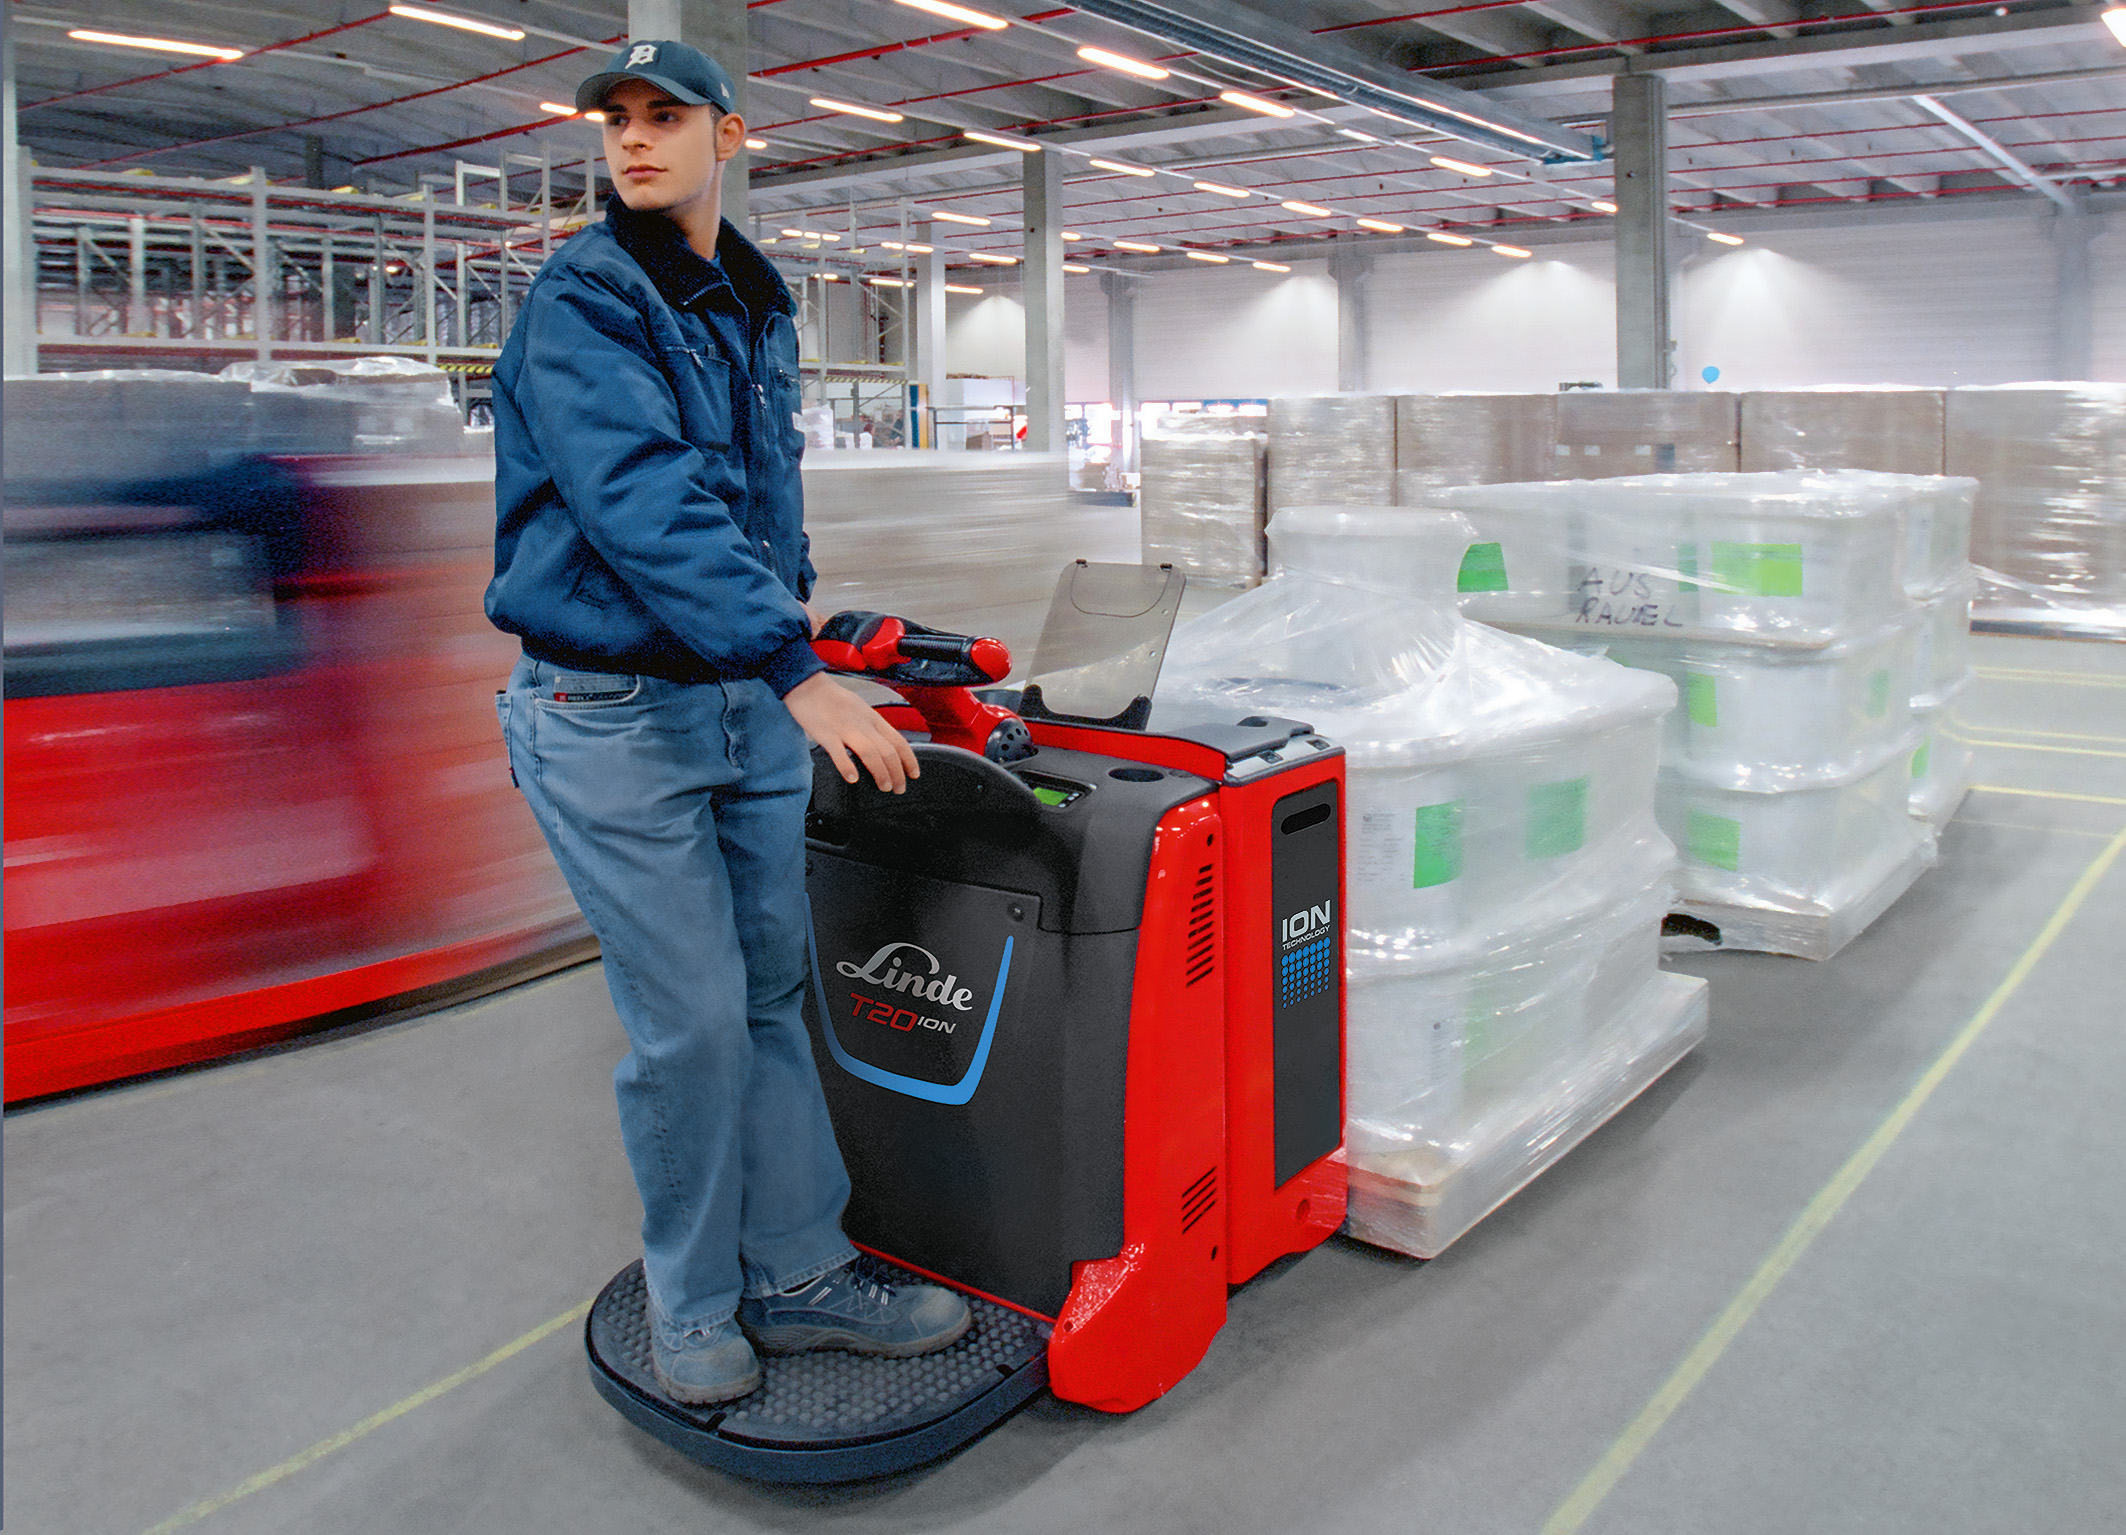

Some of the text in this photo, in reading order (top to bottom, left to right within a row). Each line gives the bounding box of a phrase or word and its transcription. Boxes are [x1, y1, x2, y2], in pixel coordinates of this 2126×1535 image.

[1577, 567, 1653, 599] AUS
[1282, 899, 1331, 943] ION
[1282, 924, 1331, 951] TECHNOLOGY
[836, 942, 973, 1011] Linde
